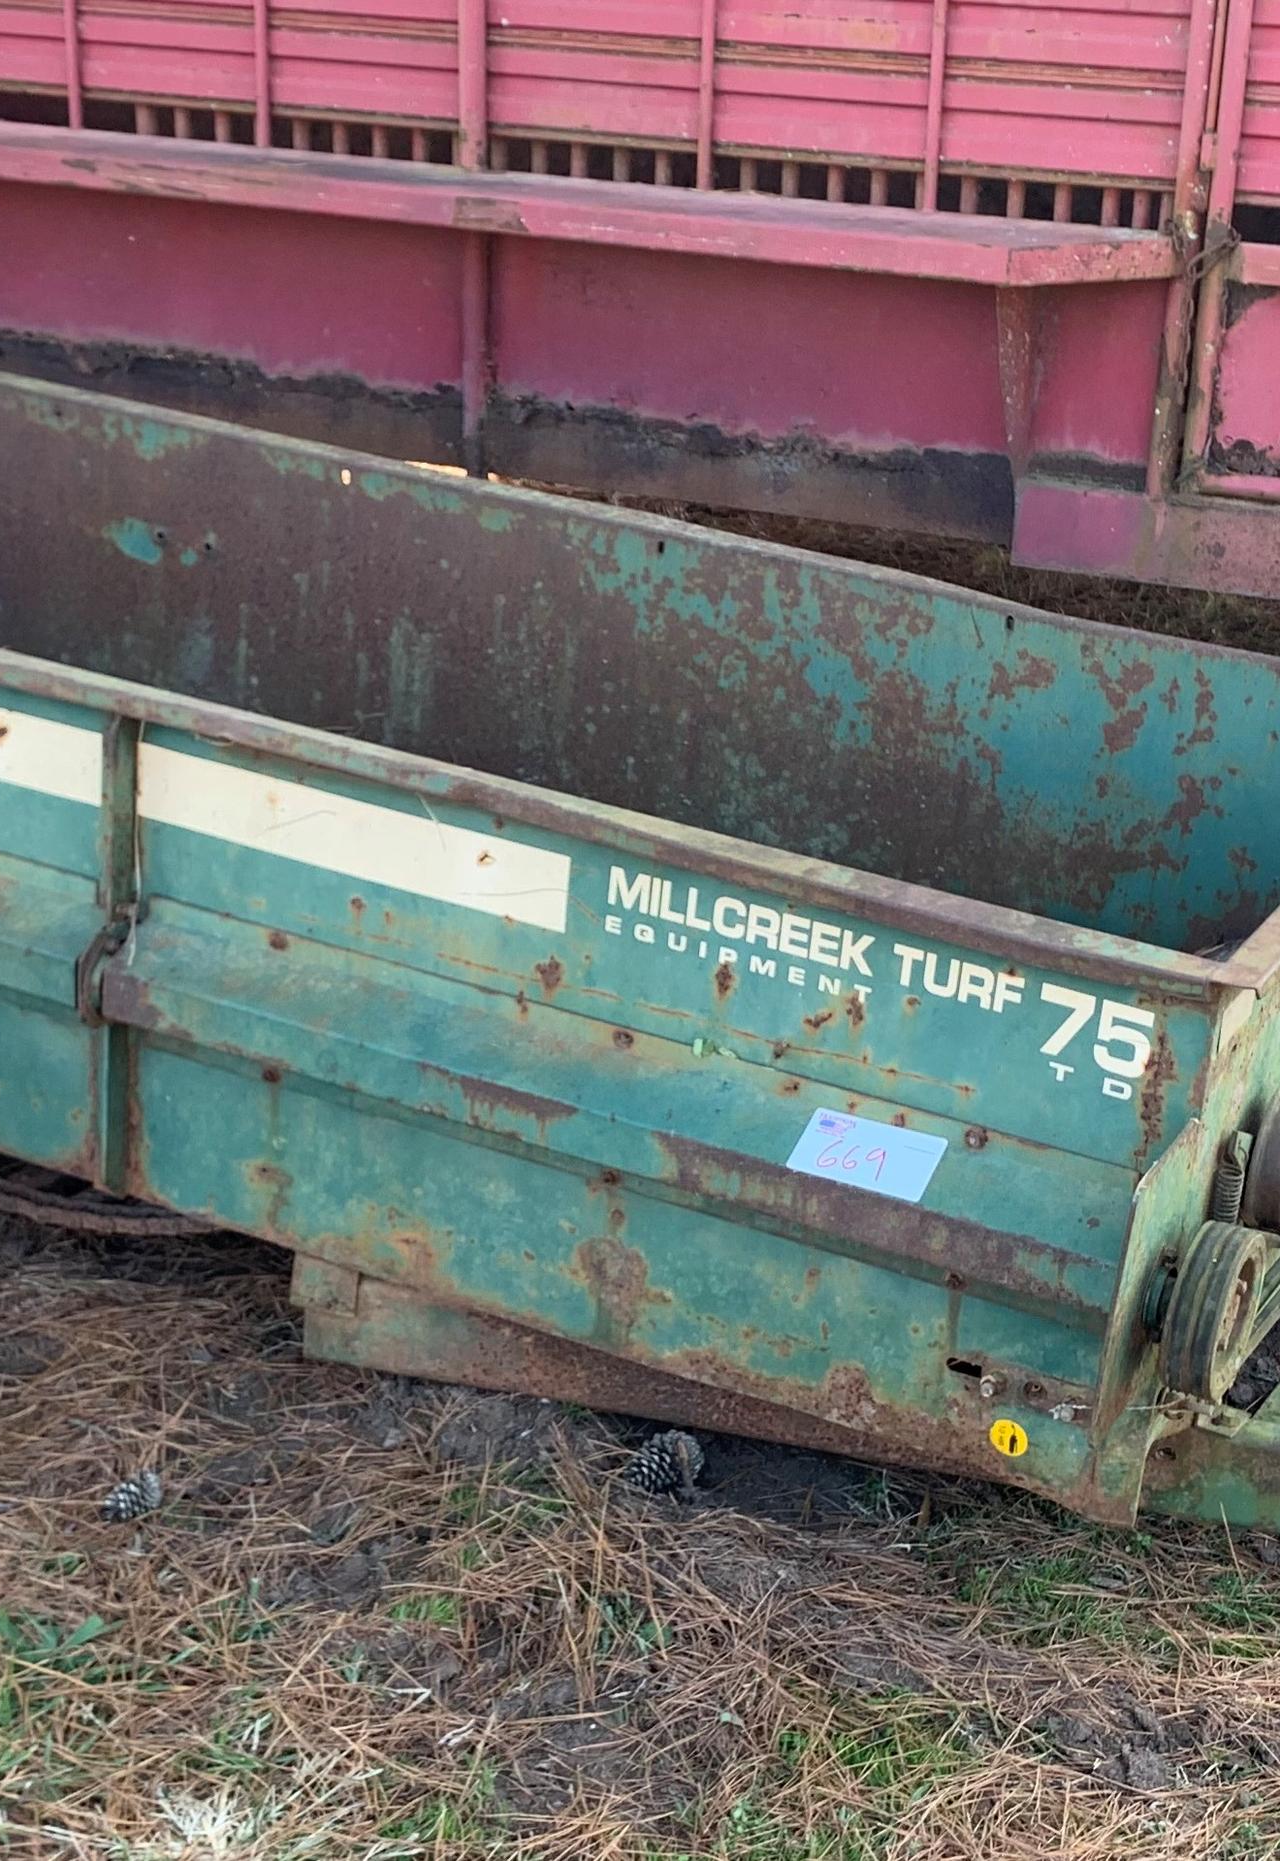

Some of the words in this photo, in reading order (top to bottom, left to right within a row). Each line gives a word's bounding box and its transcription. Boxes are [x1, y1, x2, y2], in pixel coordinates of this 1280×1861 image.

[604, 914, 873, 1004] EQUIPMENT
[607, 865, 876, 977] MILLCREEK
[893, 943, 1026, 1014] TURF
[1039, 982, 1156, 1078] 75
[816, 1139, 887, 1182] 669
